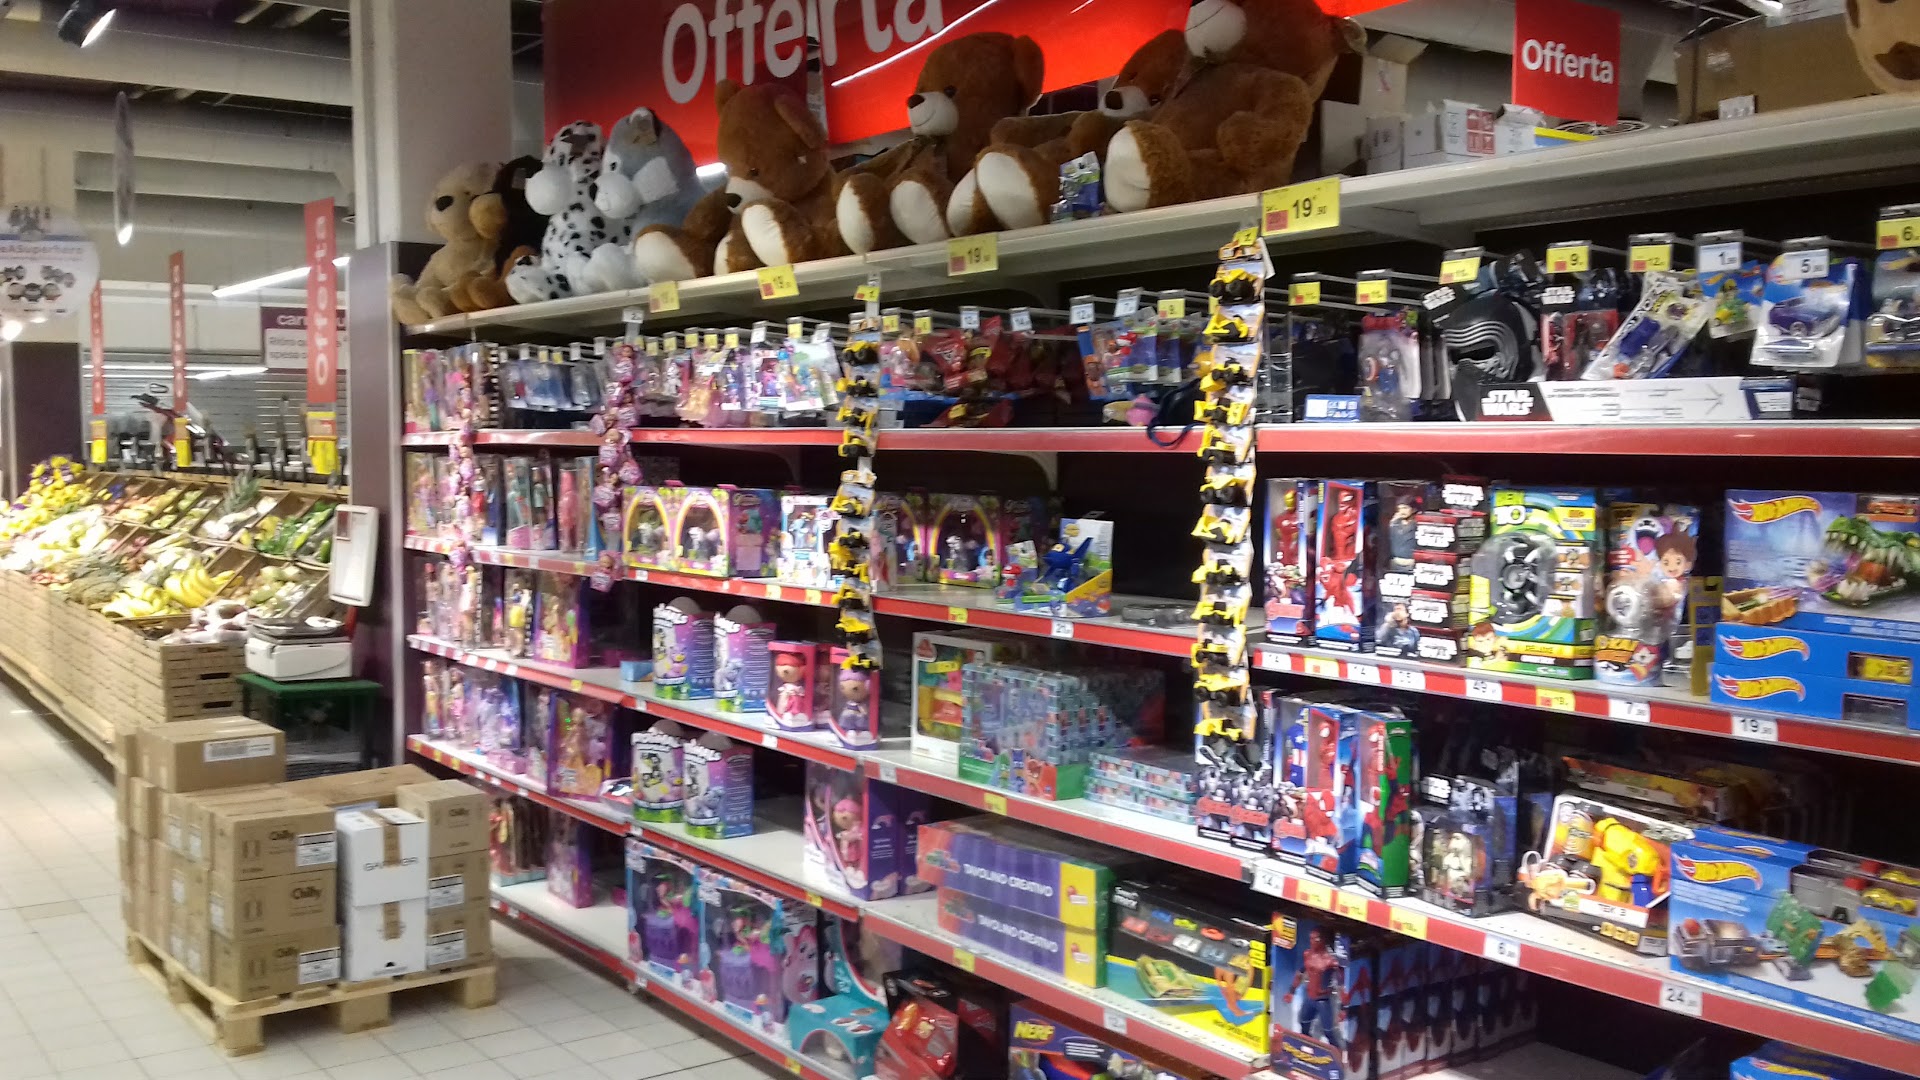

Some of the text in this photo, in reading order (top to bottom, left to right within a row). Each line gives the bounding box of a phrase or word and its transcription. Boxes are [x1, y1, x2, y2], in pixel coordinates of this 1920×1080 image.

[1521, 39, 1614, 84] Offerta
[1293, 198, 1313, 219] 19
[1801, 259, 1811, 274] 5
[1484, 390, 1531, 403] STAR
[1482, 402, 1533, 416] WARS
[1741, 717, 1759, 733] 19
[963, 863, 1008, 885] TAVOLINO
[1007, 875, 1054, 897] CREATIVO
[291, 885, 322, 900] Chilly
[976, 914, 1059, 953] TAVOLINO CREATIVO
[1013, 1020, 1056, 1042] NERF
